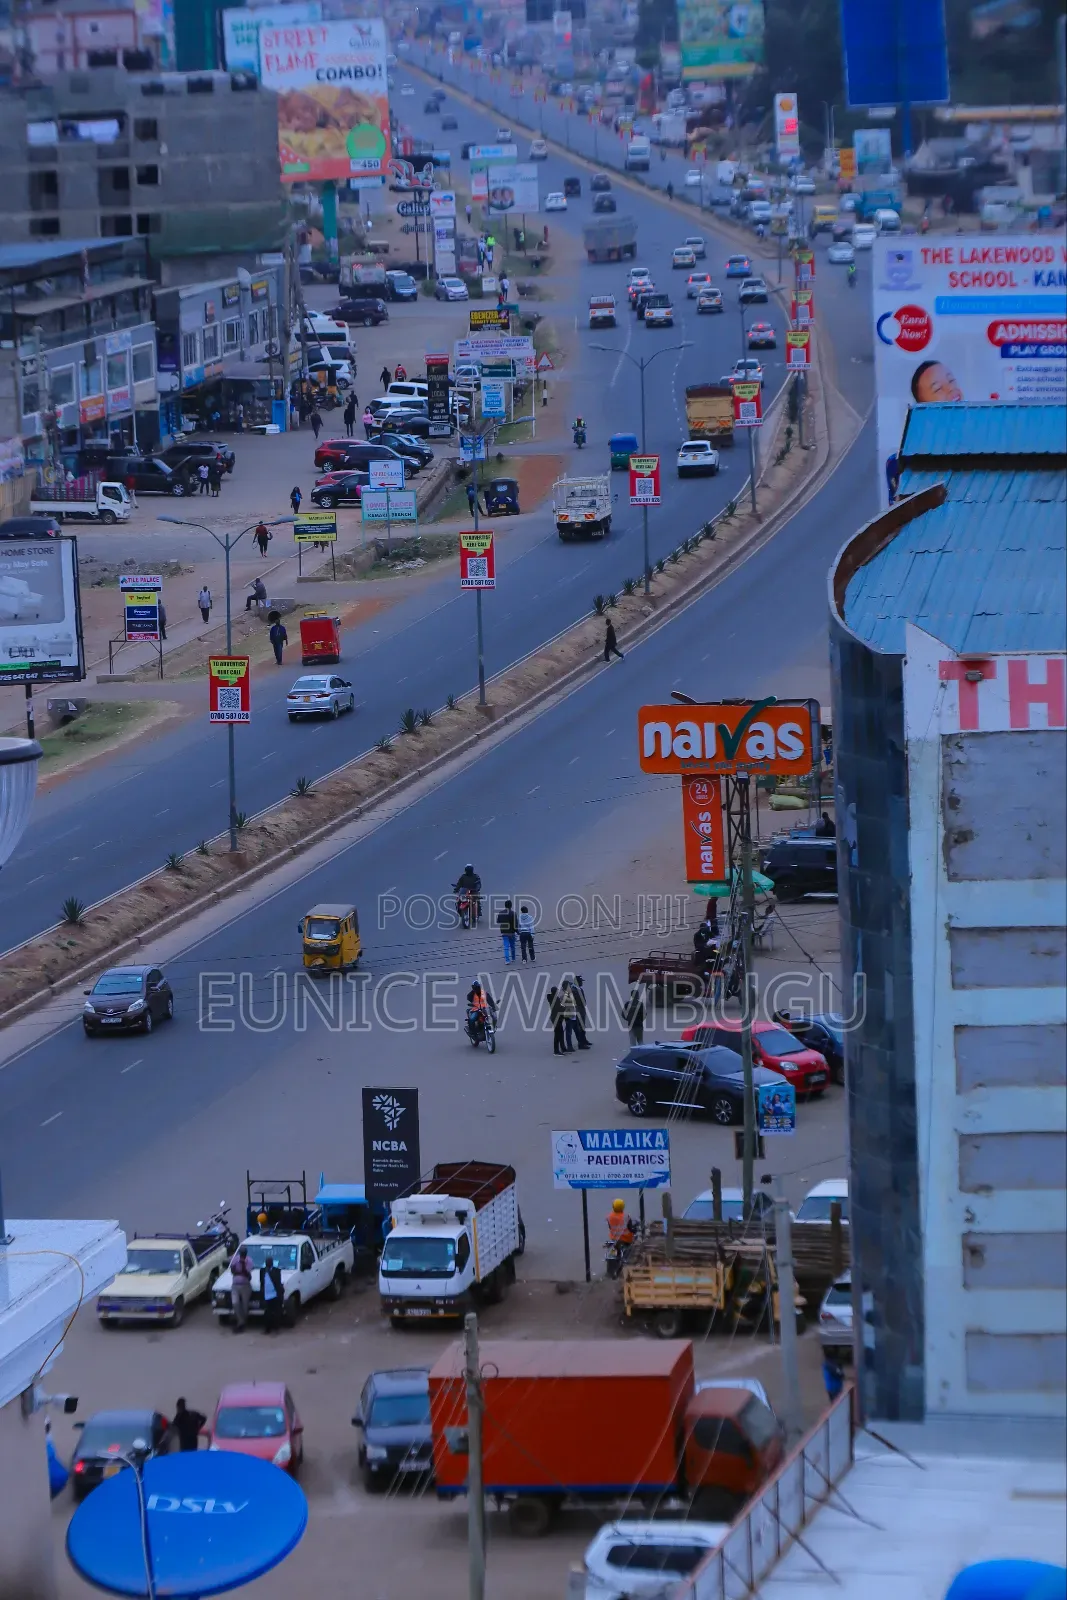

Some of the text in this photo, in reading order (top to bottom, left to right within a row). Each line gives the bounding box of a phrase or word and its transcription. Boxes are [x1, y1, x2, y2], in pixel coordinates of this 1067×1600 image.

[264, 27, 327, 49] STREET
[316, 64, 382, 81] COMBO!
[399, 202, 430, 214] Galito
[920, 247, 954, 264] THE
[960, 246, 1055, 264] LAKEWOOD
[949, 270, 1017, 288] SCHOOL
[901, 314, 928, 325] Enrol
[901, 328, 927, 339] Now!
[1010, 346, 1037, 355] PLAY
[1, 547, 54, 557] HOME STORE
[938, 659, 1065, 730] TH
[210, 712, 225, 720] 0700
[643, 697, 804, 760] naivas
[696, 784, 707, 794] 24
[691, 811, 713, 874] naivas
[372, 1140, 408, 1151] NCBA
[586, 1132, 665, 1149] MALAIKA
[587, 1154, 664, 1165] PAEDIATRICS
